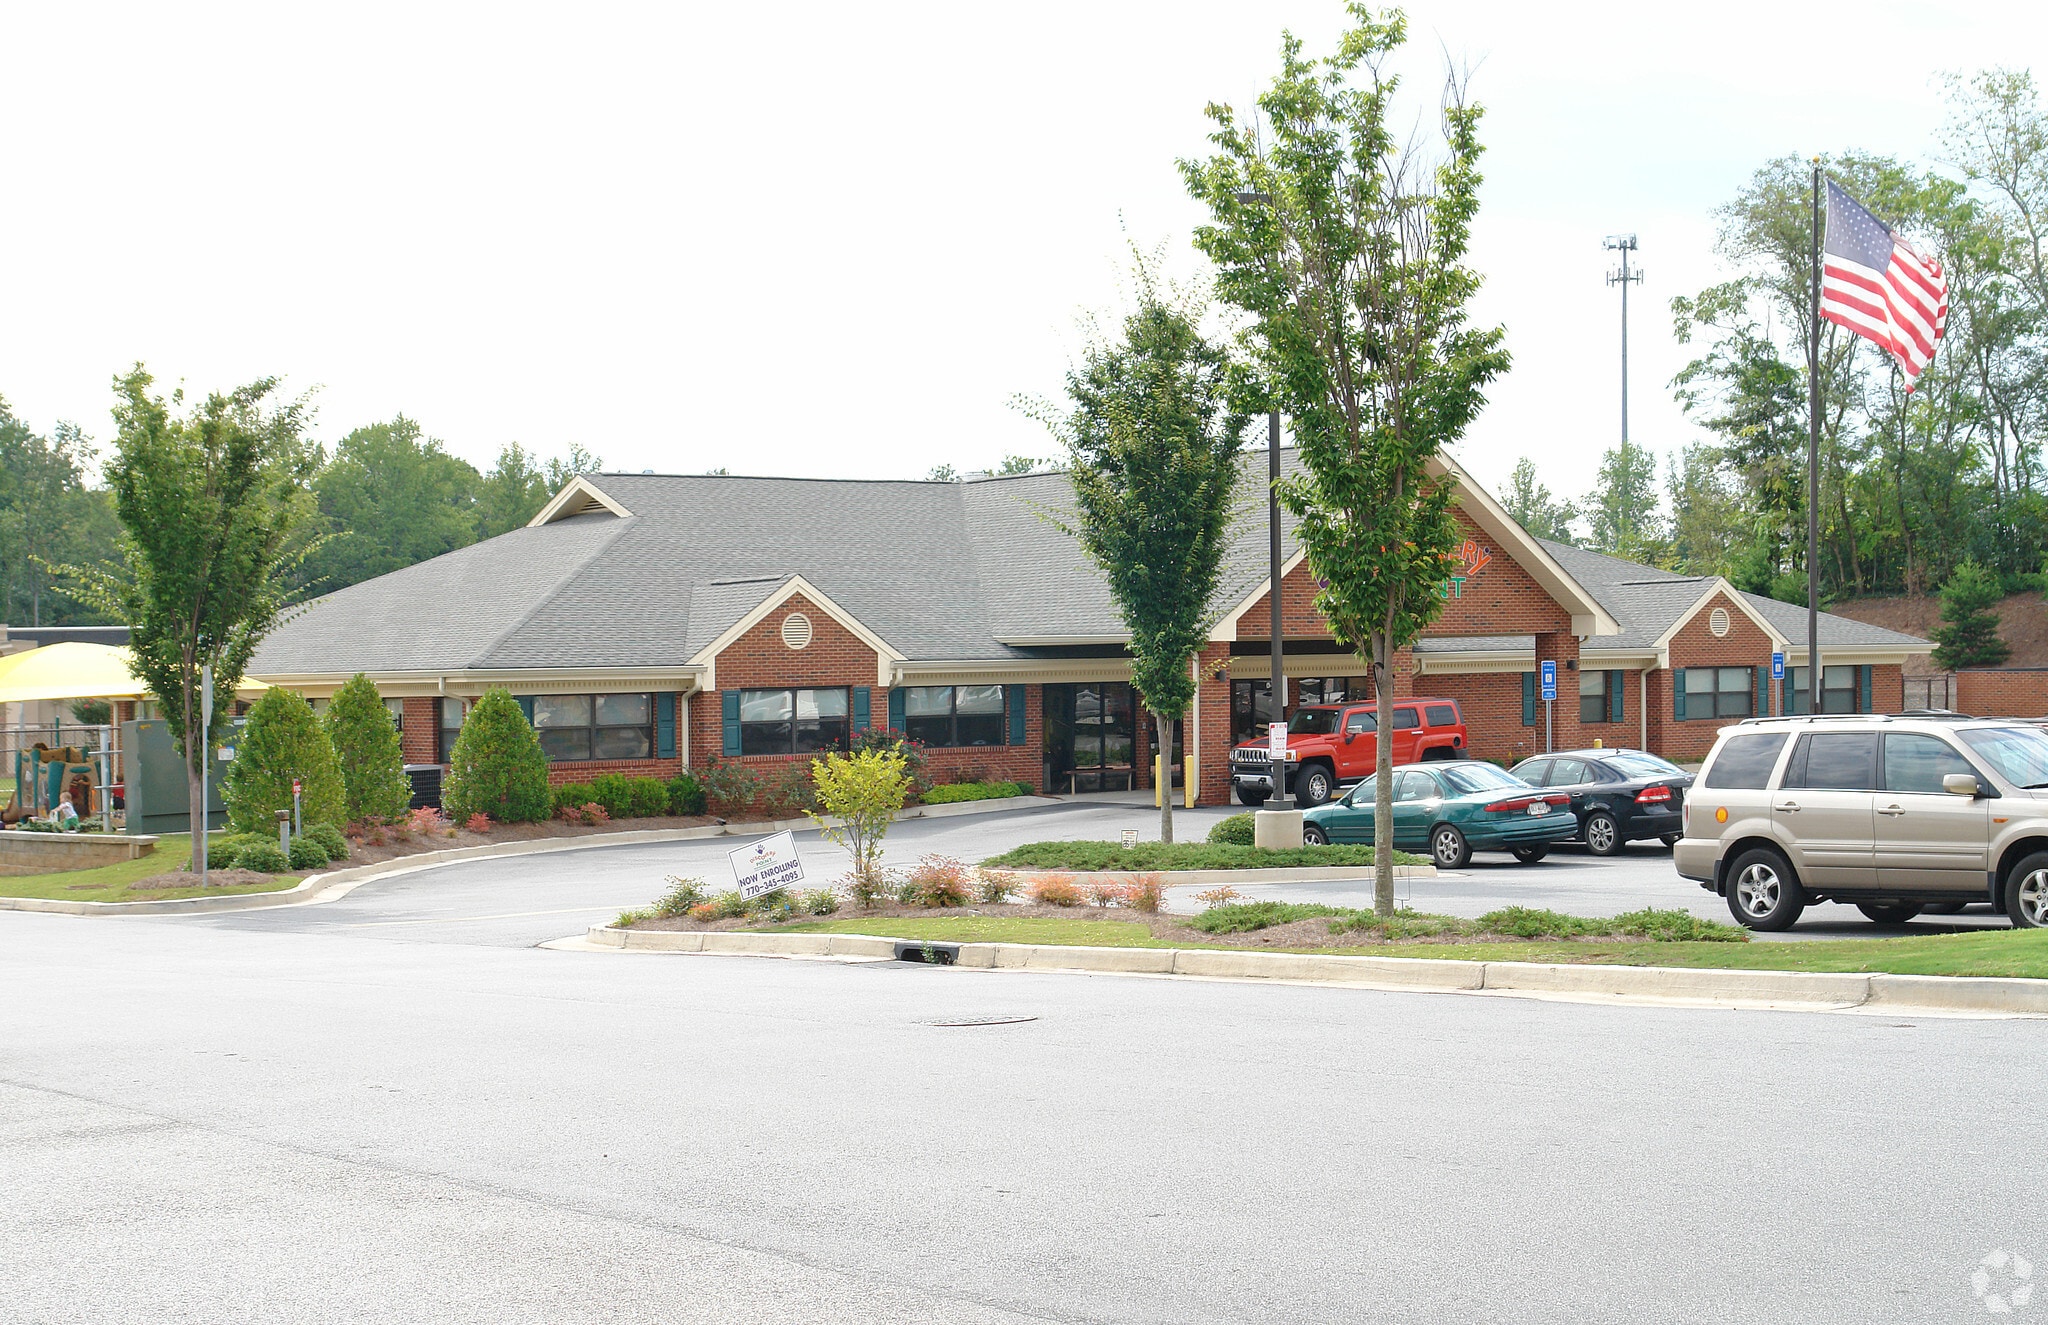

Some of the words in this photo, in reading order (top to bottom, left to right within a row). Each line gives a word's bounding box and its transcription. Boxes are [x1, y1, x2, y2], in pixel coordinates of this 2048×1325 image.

[739, 874, 758, 887] NOW
[760, 859, 799, 879] ENROLLING
[745, 870, 799, 896] 770-345-4095
